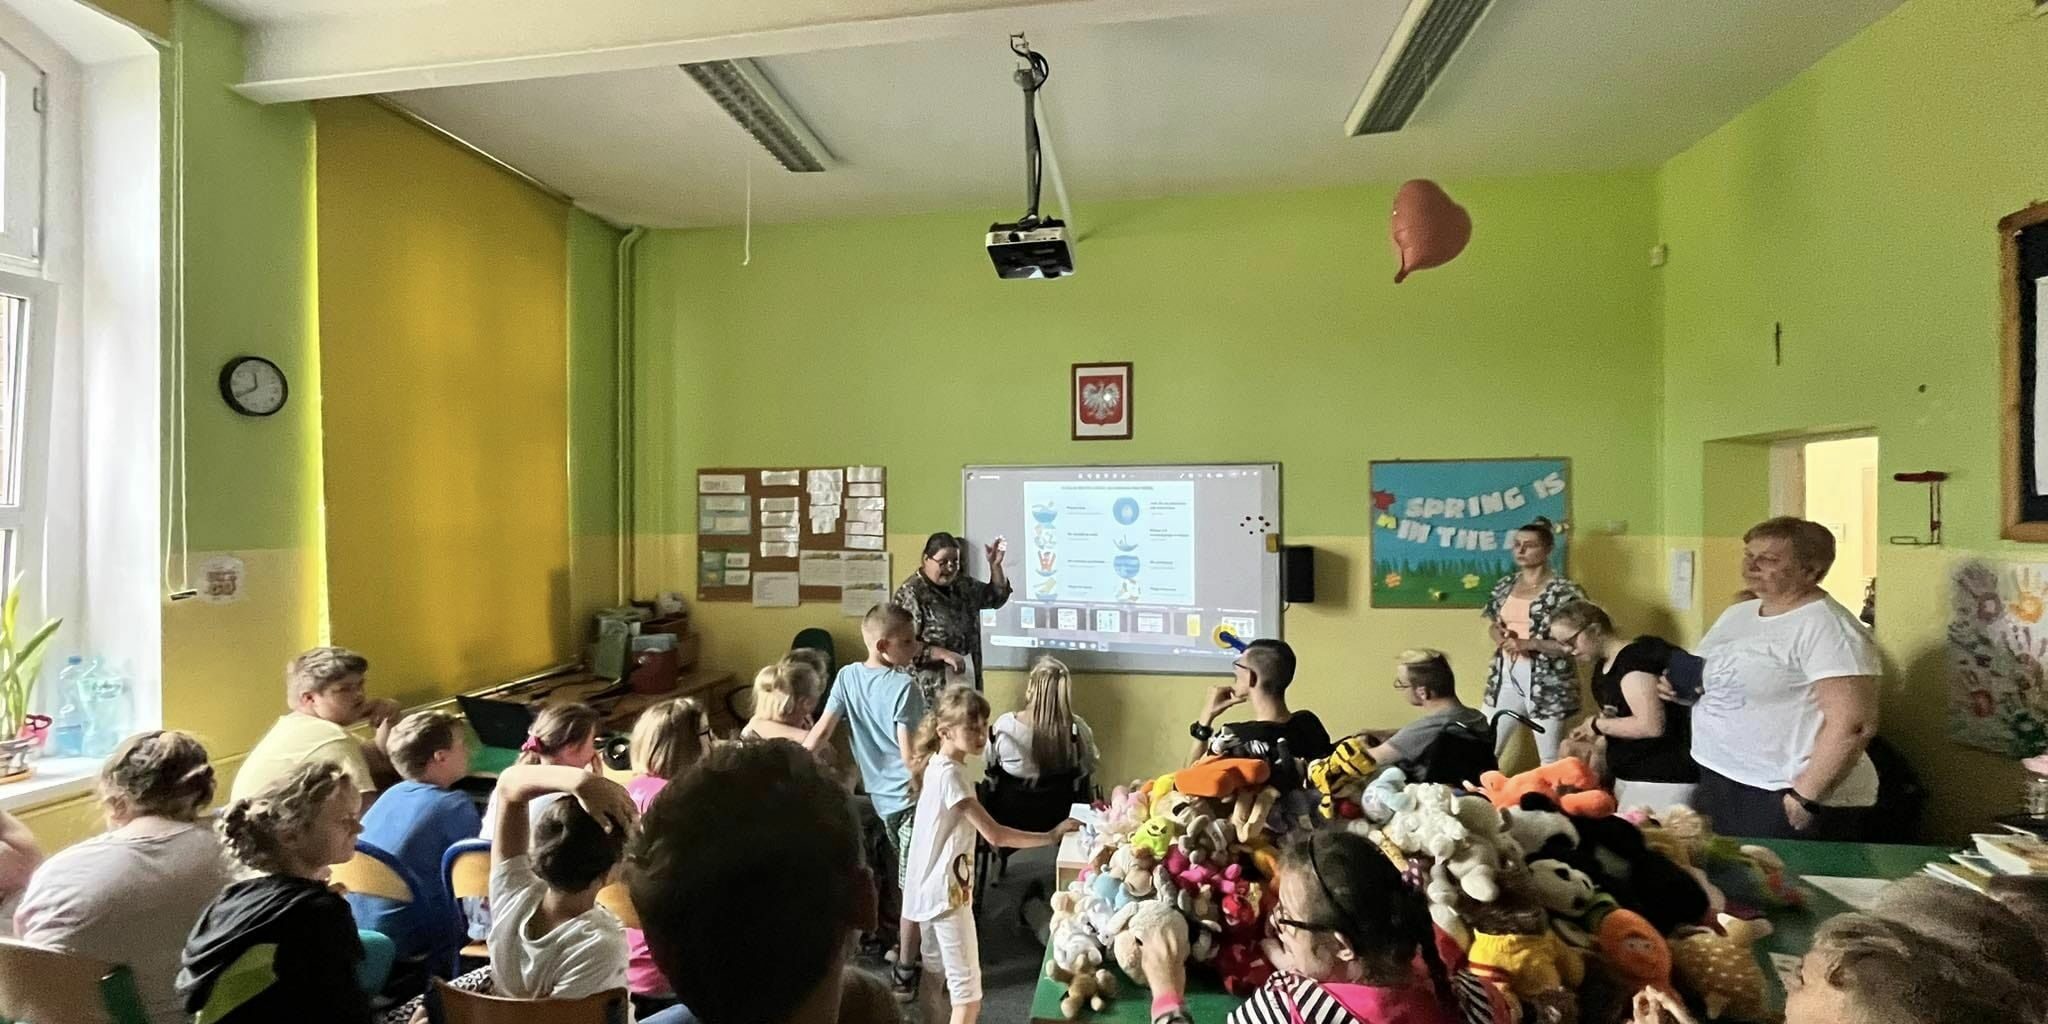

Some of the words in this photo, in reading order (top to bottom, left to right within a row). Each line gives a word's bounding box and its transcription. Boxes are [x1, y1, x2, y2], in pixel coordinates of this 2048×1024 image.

[1406, 487, 1526, 518] SPRING
[1533, 472, 1566, 499] IS
[1397, 519, 1431, 543] IN
[1437, 526, 1498, 551] THE
